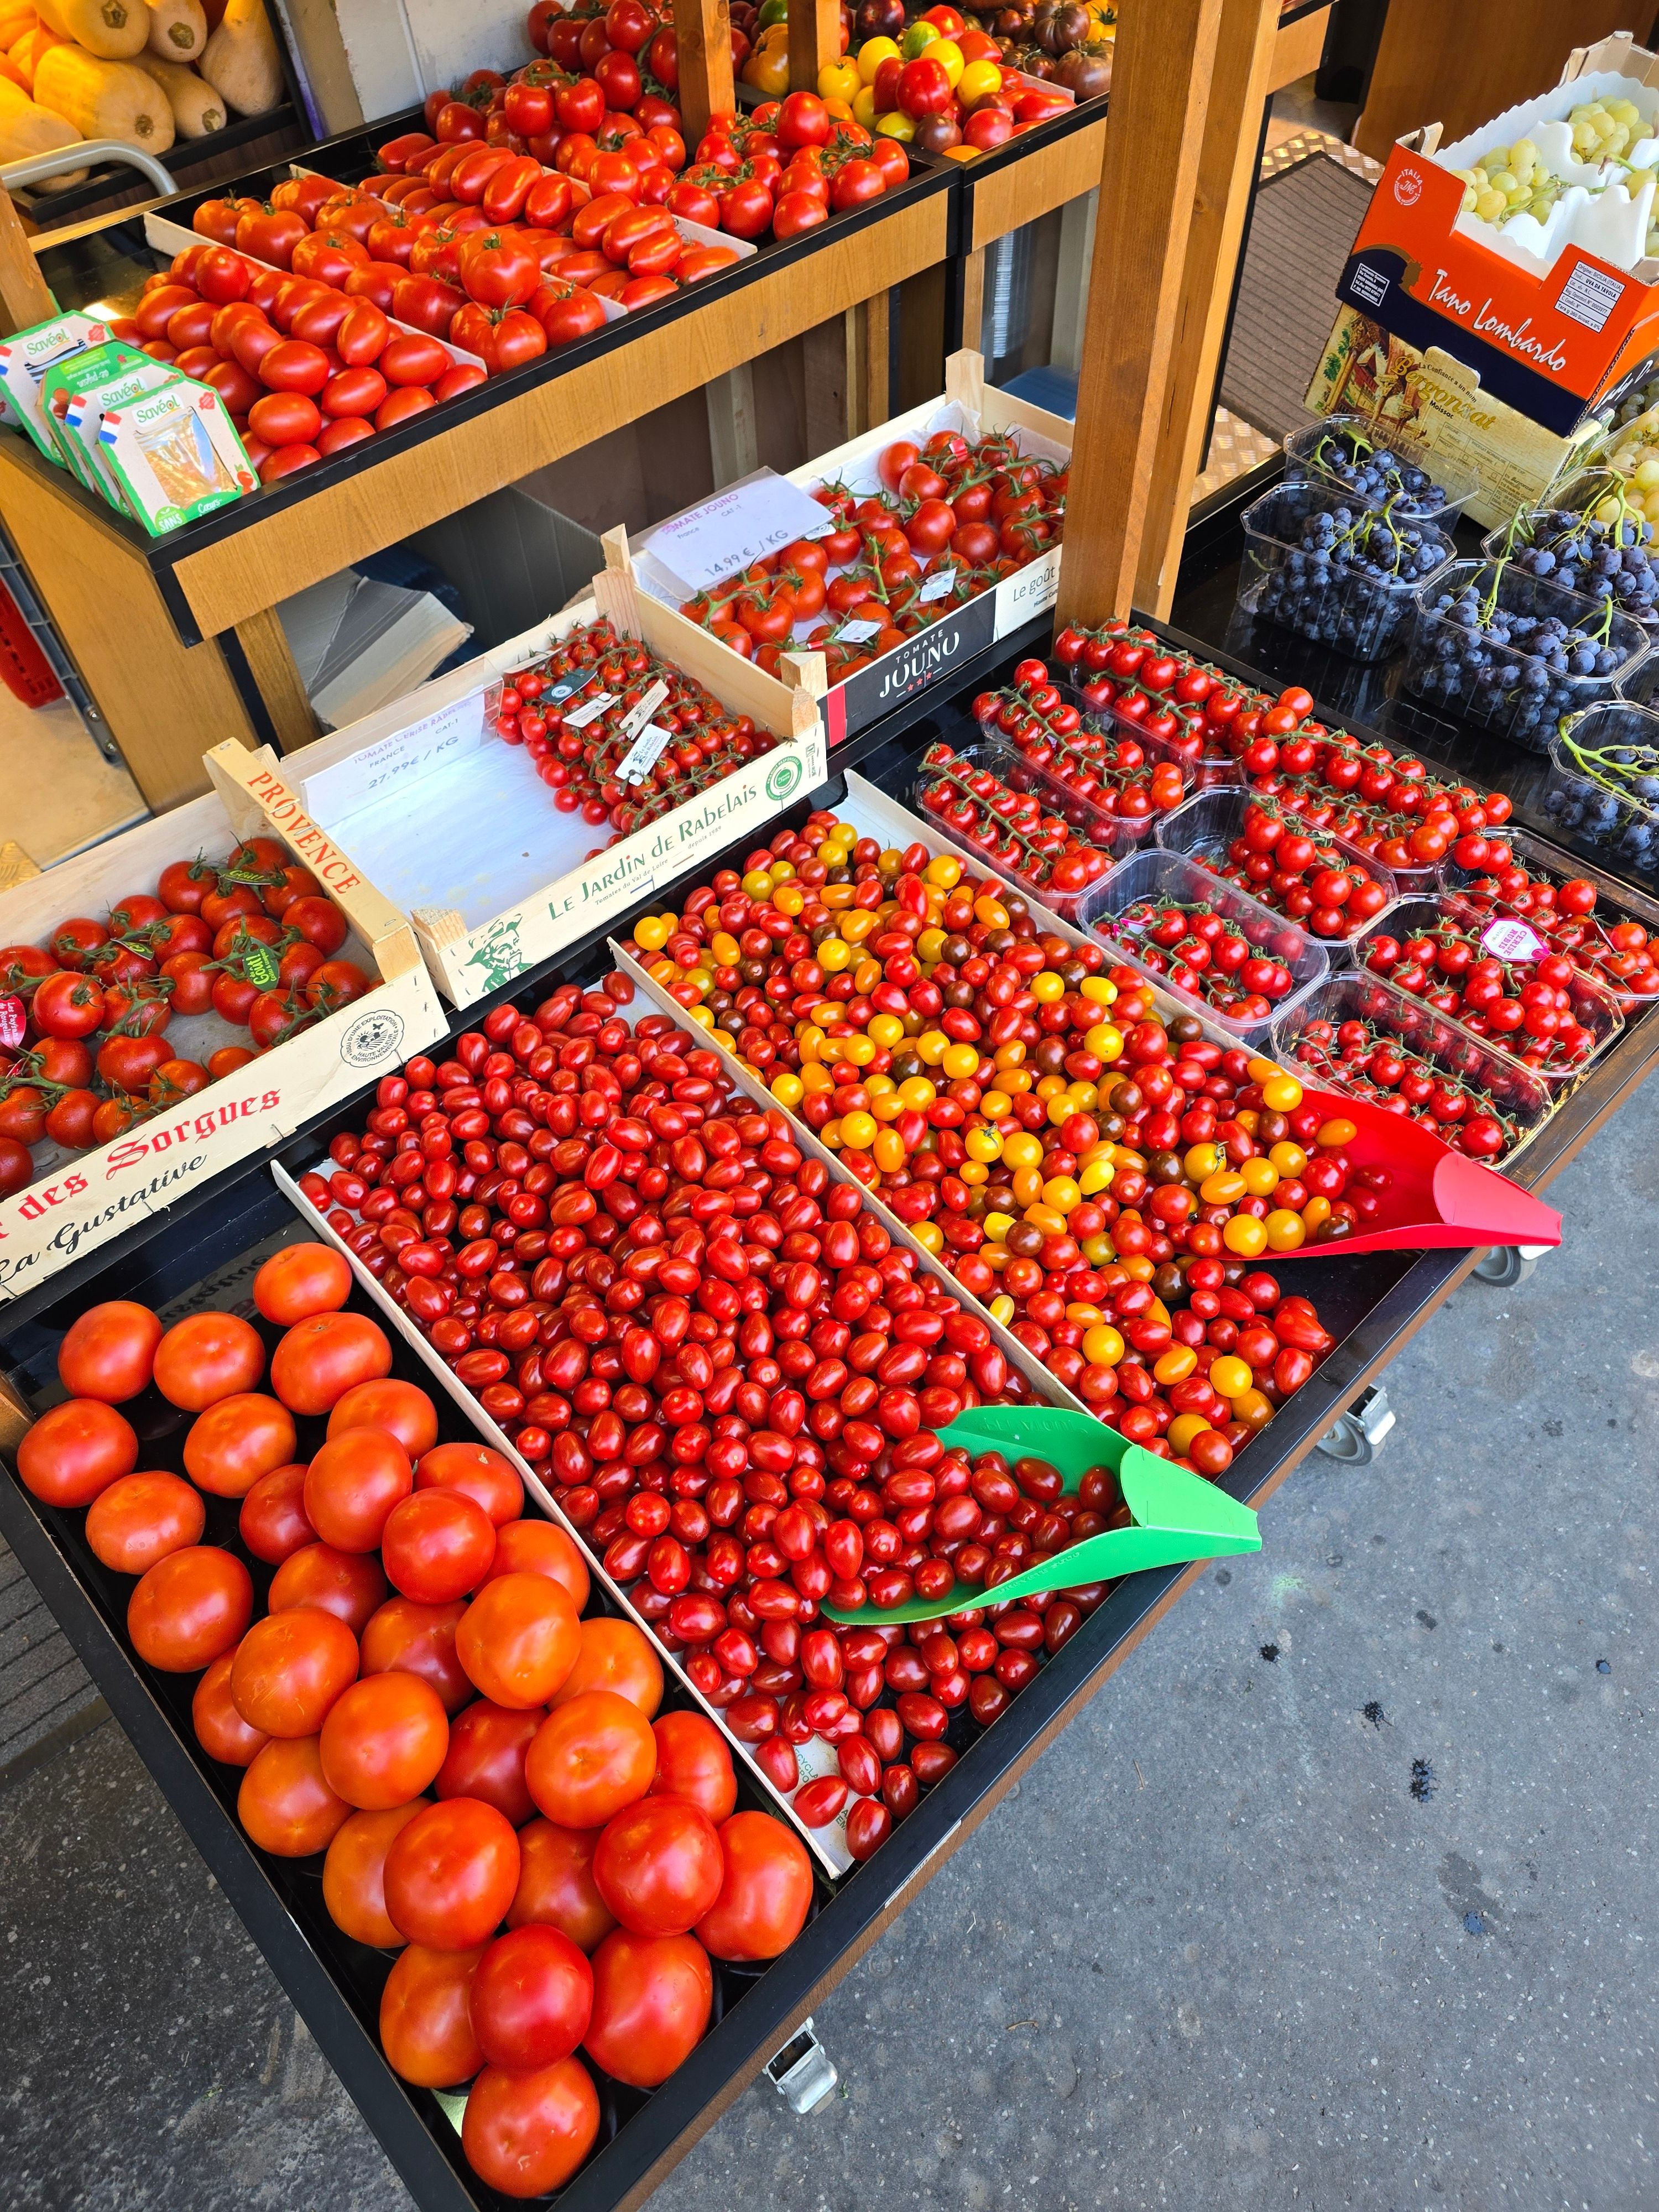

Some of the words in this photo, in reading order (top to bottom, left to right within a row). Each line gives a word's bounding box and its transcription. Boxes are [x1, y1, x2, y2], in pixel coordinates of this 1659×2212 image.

[1401, 169, 1423, 186] ITALIA
[1585, 278, 1594, 286] UVA
[1600, 285, 1616, 299] TAVOLA
[1593, 272, 1606, 283] SICILIA
[1427, 269, 1471, 315] Tano
[1473, 298, 1566, 371] Lombardo
[1557, 303, 1567, 311] Tara
[27, 328, 70, 356] Savéol
[102, 378, 145, 406] Savéol
[1427, 364, 1454, 382] Confiance
[1458, 383, 1466, 392] un
[1465, 390, 1477, 403] nom
[137, 395, 181, 424] Savéol
[1429, 400, 1454, 419] Moissac
[705, 493, 739, 515] JOUNO
[158, 513, 183, 532] SANS
[677, 526, 700, 540] France
[705, 553, 741, 576] 14,99
[742, 547, 755, 557] €
[765, 529, 789, 545] KG
[1013, 586, 1026, 602] Le
[1029, 566, 1056, 595] goût
[895, 629, 943, 664] TOMATE
[879, 632, 959, 698] JOUNO
[435, 718, 458, 734] CAT-1
[369, 745, 405, 768] FRANCE
[436, 736, 459, 753] KG
[247, 771, 361, 895] PROVENCE
[687, 834, 707, 849] depuis
[709, 825, 722, 837] 1989
[594, 887, 622, 906] Tomates
[632, 874, 642, 883] Val
[651, 859, 669, 872] Loire
[1498, 928, 1519, 950] RUBIS
[1503, 930, 1527, 956] CERISE
[246, 953, 269, 985] Goût!
[7, 1002, 15, 1013] Les
[348, 1024, 362, 1041] D'UNE
[361, 1015, 398, 1027] EXPLOITATION
[351, 1029, 399, 1062] ENVIRONNEMENTALE
[376, 1033, 394, 1053] VALEUR
[18, 1172, 88, 1220] des
[106, 1088, 281, 1181] Sorgues
[46, 1154, 207, 1255] Gustative
